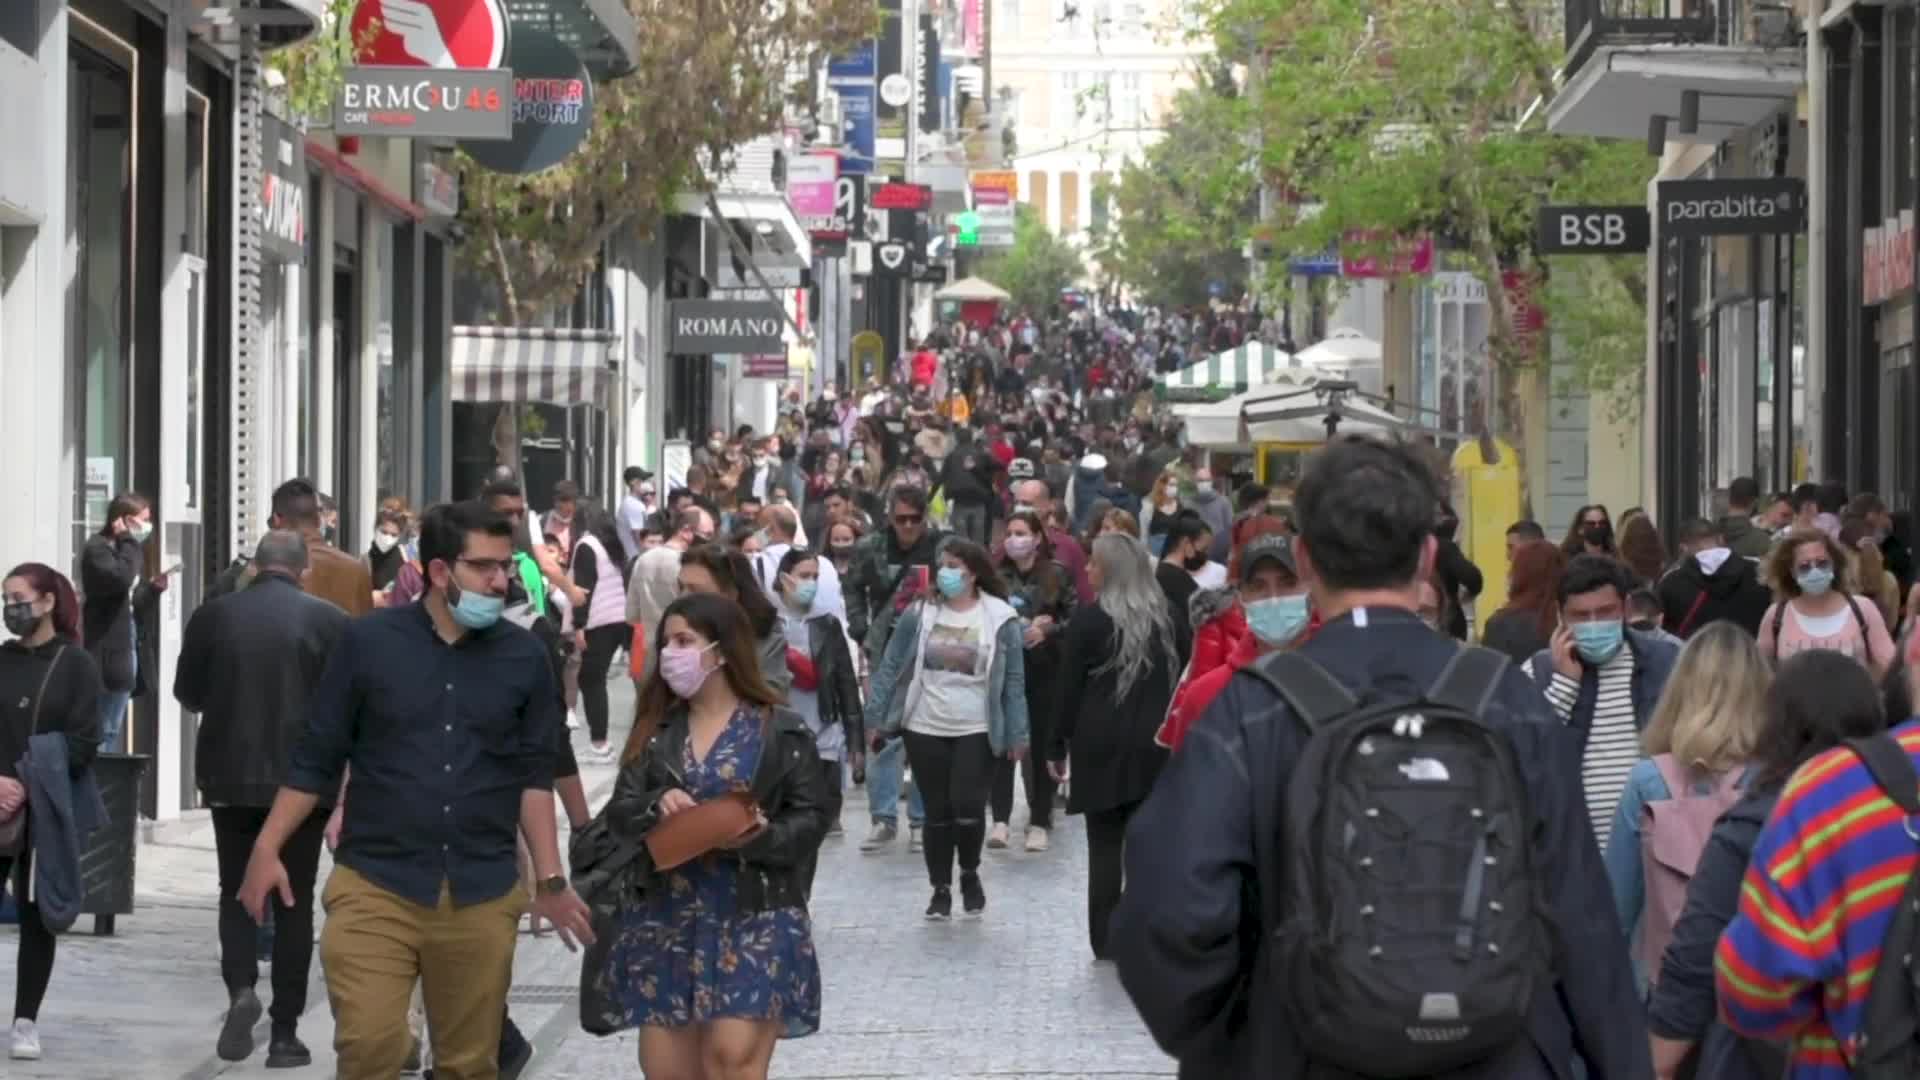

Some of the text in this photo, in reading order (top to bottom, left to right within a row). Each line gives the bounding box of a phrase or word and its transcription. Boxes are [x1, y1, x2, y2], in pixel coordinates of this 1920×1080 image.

[343, 80, 502, 112] ERMOU 46
[1667, 194, 1775, 222] parabita
[1560, 214, 1626, 246] BSB
[678, 317, 778, 337] ROMANO
